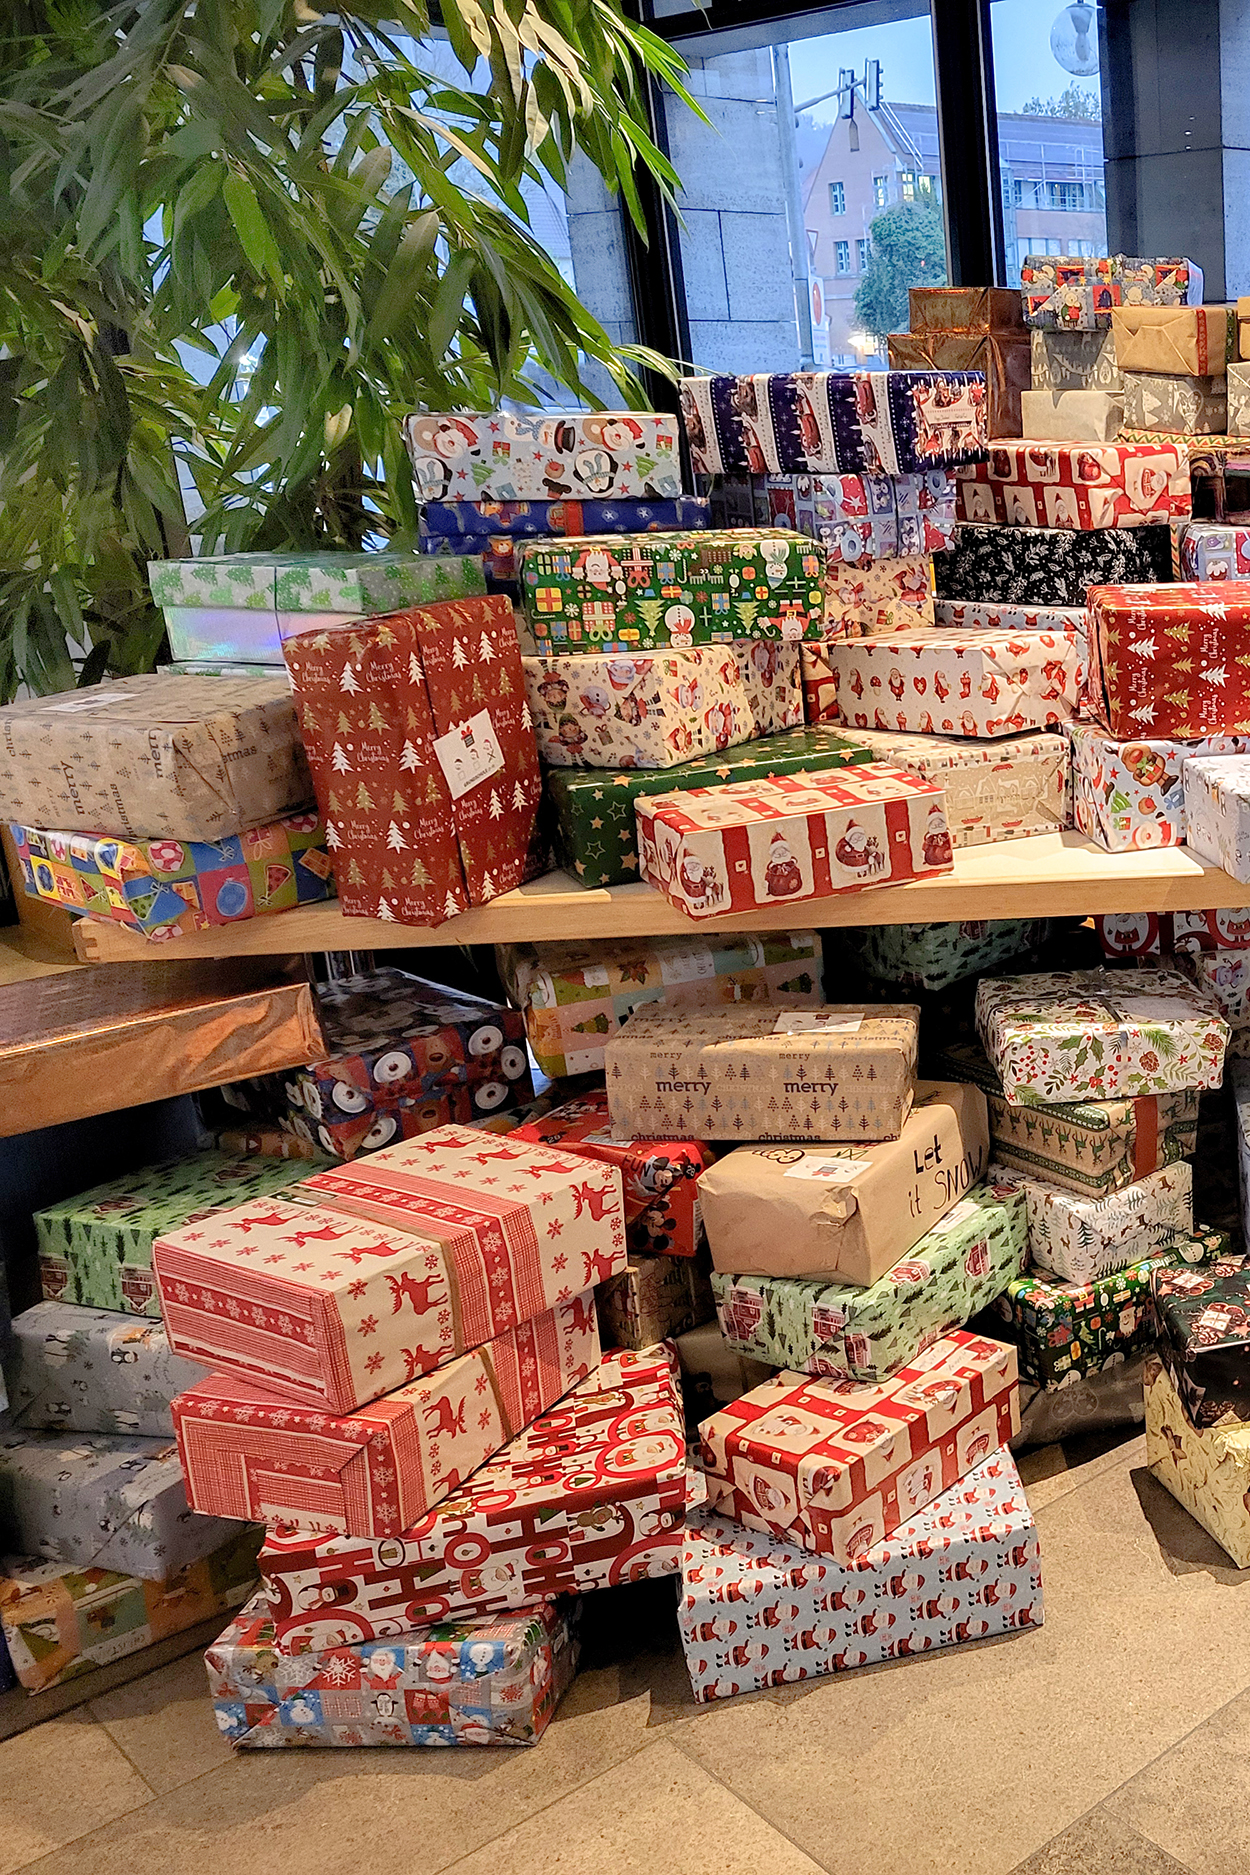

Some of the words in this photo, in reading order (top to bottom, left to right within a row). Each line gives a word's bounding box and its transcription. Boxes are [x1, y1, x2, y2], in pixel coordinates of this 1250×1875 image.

[1200, 634, 1210, 653] Merry
[1209, 628, 1219, 659] Christmas
[305, 662, 324, 675] Merry
[370, 661, 394, 674] Merry
[302, 670, 330, 684] Christmas
[366, 669, 402, 683] Christmas
[1129, 672, 1140, 692] Merry
[1138, 667, 1148, 698] Christmas
[1199, 700, 1208, 719] Merry
[1208, 694, 1218, 724] Christmas
[362, 740, 382, 753] Merry
[357, 749, 389, 763] Christmas
[60, 760, 85, 816] merry
[351, 819, 370, 833] Merry
[419, 817, 438, 830] Merry
[348, 827, 378, 841] Christmas
[414, 826, 444, 840] Christmas
[650, 1052, 682, 1060] merry
[779, 1052, 811, 1061] merry
[655, 1080, 712, 1095] merry
[783, 1081, 839, 1096] merry
[913, 1134, 942, 1174] Let
[622, 1154, 651, 1177] FUN
[908, 1184, 922, 1218] it
[934, 1145, 982, 1210] SNOW
[324, 1696, 362, 1718] HO
